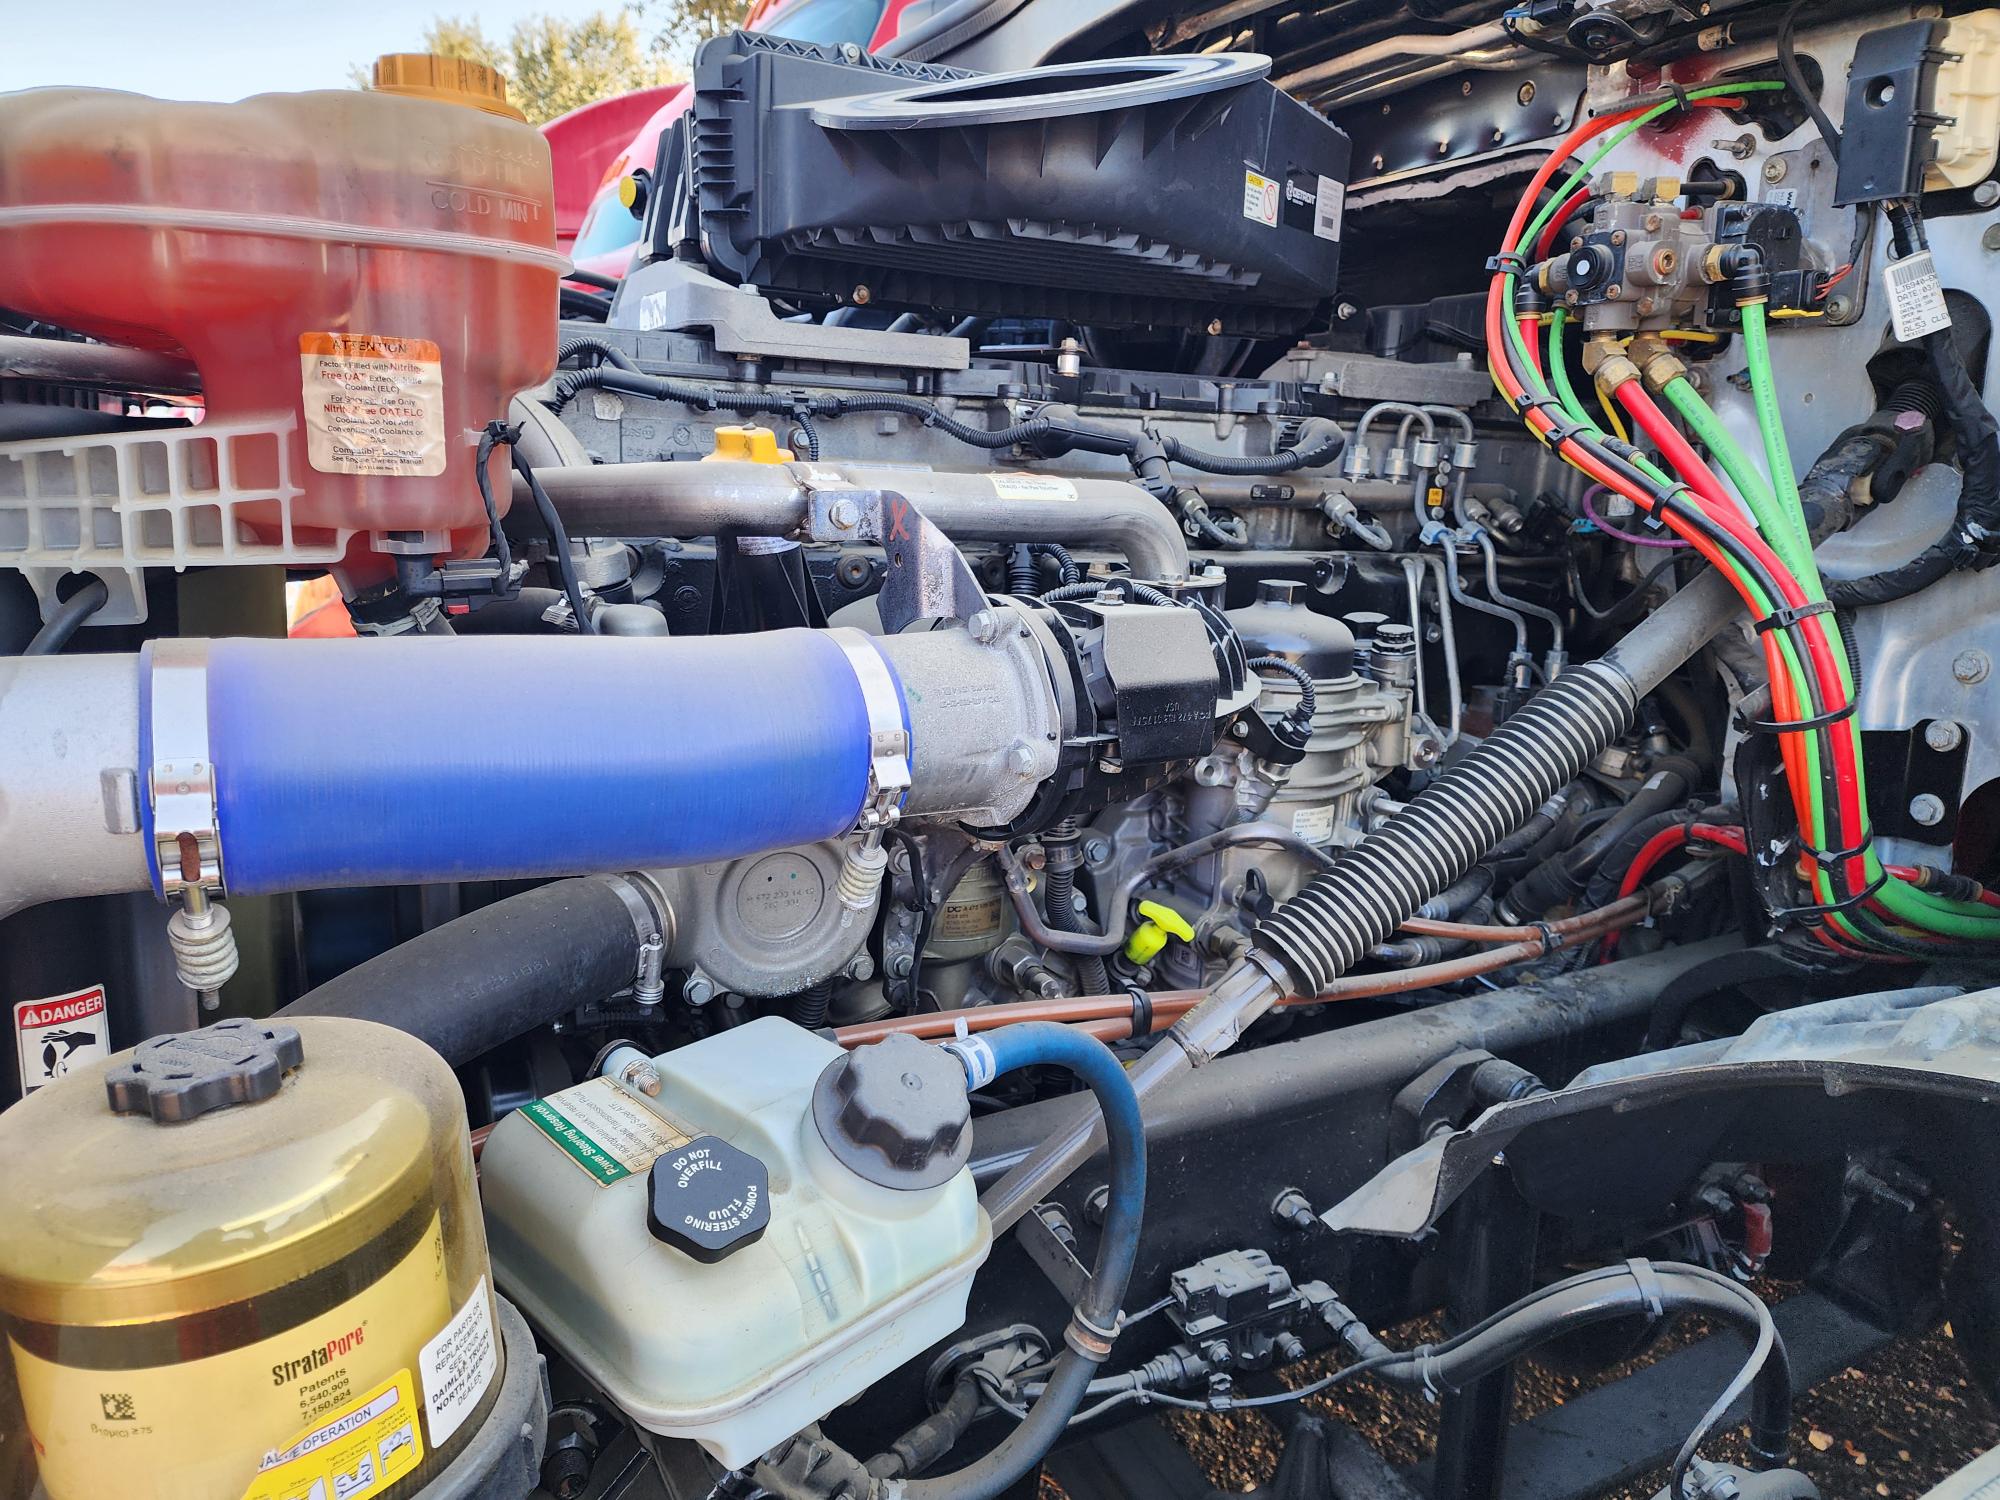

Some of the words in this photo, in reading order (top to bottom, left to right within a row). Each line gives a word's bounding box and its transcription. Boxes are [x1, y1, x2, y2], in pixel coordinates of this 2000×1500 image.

[432, 190, 490, 214] COLD
[499, 199, 528, 223] MIN
[319, 361, 348, 370] Facto
[321, 370, 342, 380] Free
[331, 395, 343, 403] For
[344, 383, 376, 392] Coolant
[377, 384, 400, 394] (ELC)
[379, 407, 402, 417] OAT
[404, 408, 424, 418] ELC
[40, 995, 103, 1024] DANGER
[532, 1103, 569, 1132] Reservoir
[563, 1127, 598, 1158] Steering
[593, 1154, 619, 1177] Power
[672, 1157, 688, 1171] DO
[688, 1149, 711, 1161] NOT
[677, 1160, 722, 1188] OVERFILL
[709, 1198, 743, 1220] FLUID
[739, 1185, 758, 1220] POWER
[684, 1215, 741, 1232] STEERING
[435, 1312, 484, 1374] REPLACEMENTS
[436, 1337, 452, 1359] FOR
[453, 1314, 473, 1341] PARTS
[471, 1301, 481, 1319] OR
[469, 1327, 489, 1362] TRUCKS
[272, 1326, 365, 1386] StrataPore
[449, 1355, 463, 1374] SEE
[462, 1332, 480, 1357] YOUR
[299, 1367, 347, 1397] Patents
[299, 1378, 350, 1409] 6,540,909
[436, 1377, 465, 1415] NORTH
[466, 1342, 490, 1386] AMERICA
[457, 1372, 483, 1407] DEALER
[302, 1389, 352, 1420] 7,150,824
[303, 1407, 372, 1450] OPERATION
